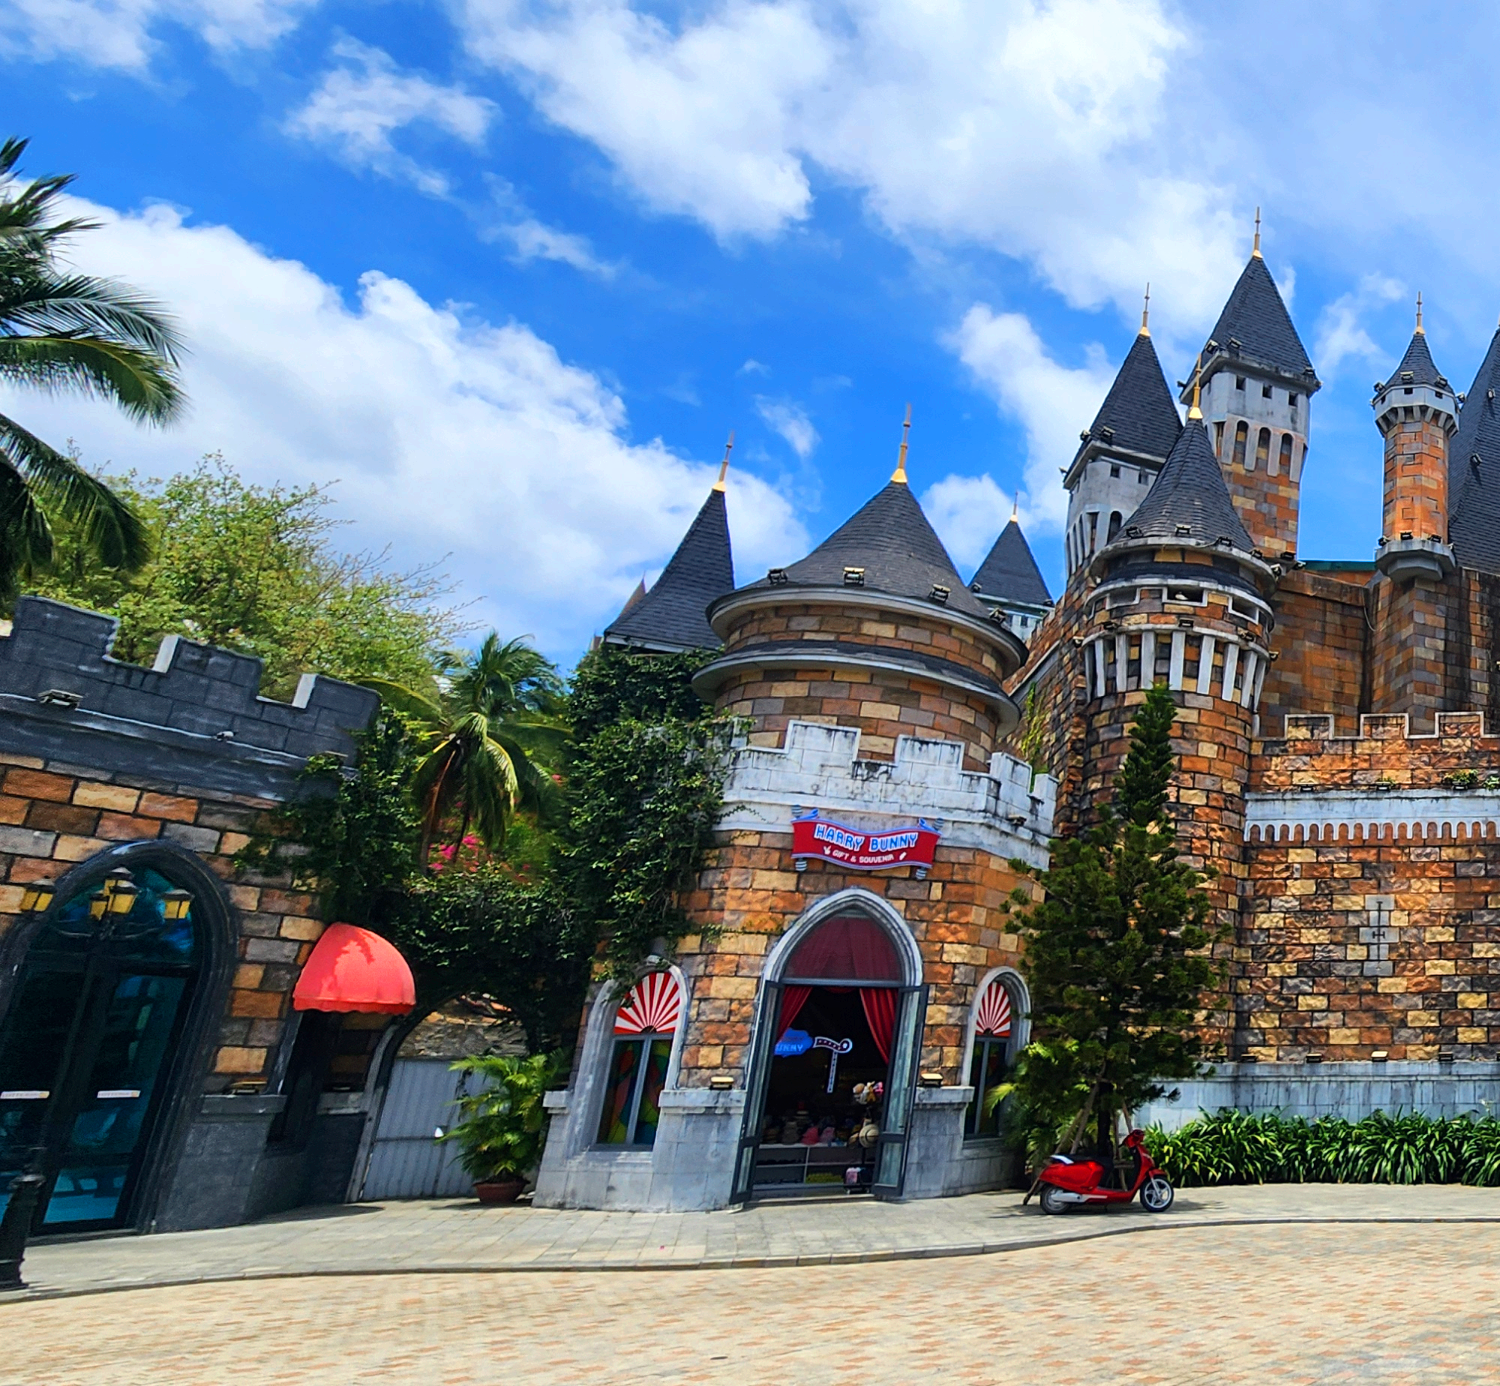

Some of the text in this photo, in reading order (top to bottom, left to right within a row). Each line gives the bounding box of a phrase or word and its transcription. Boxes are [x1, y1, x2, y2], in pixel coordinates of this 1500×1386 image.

[814, 823, 919, 852] HARRY BUNNY
[832, 849, 894, 864] GIFT & SOUVENIR
[775, 1043, 803, 1052] UNNY
